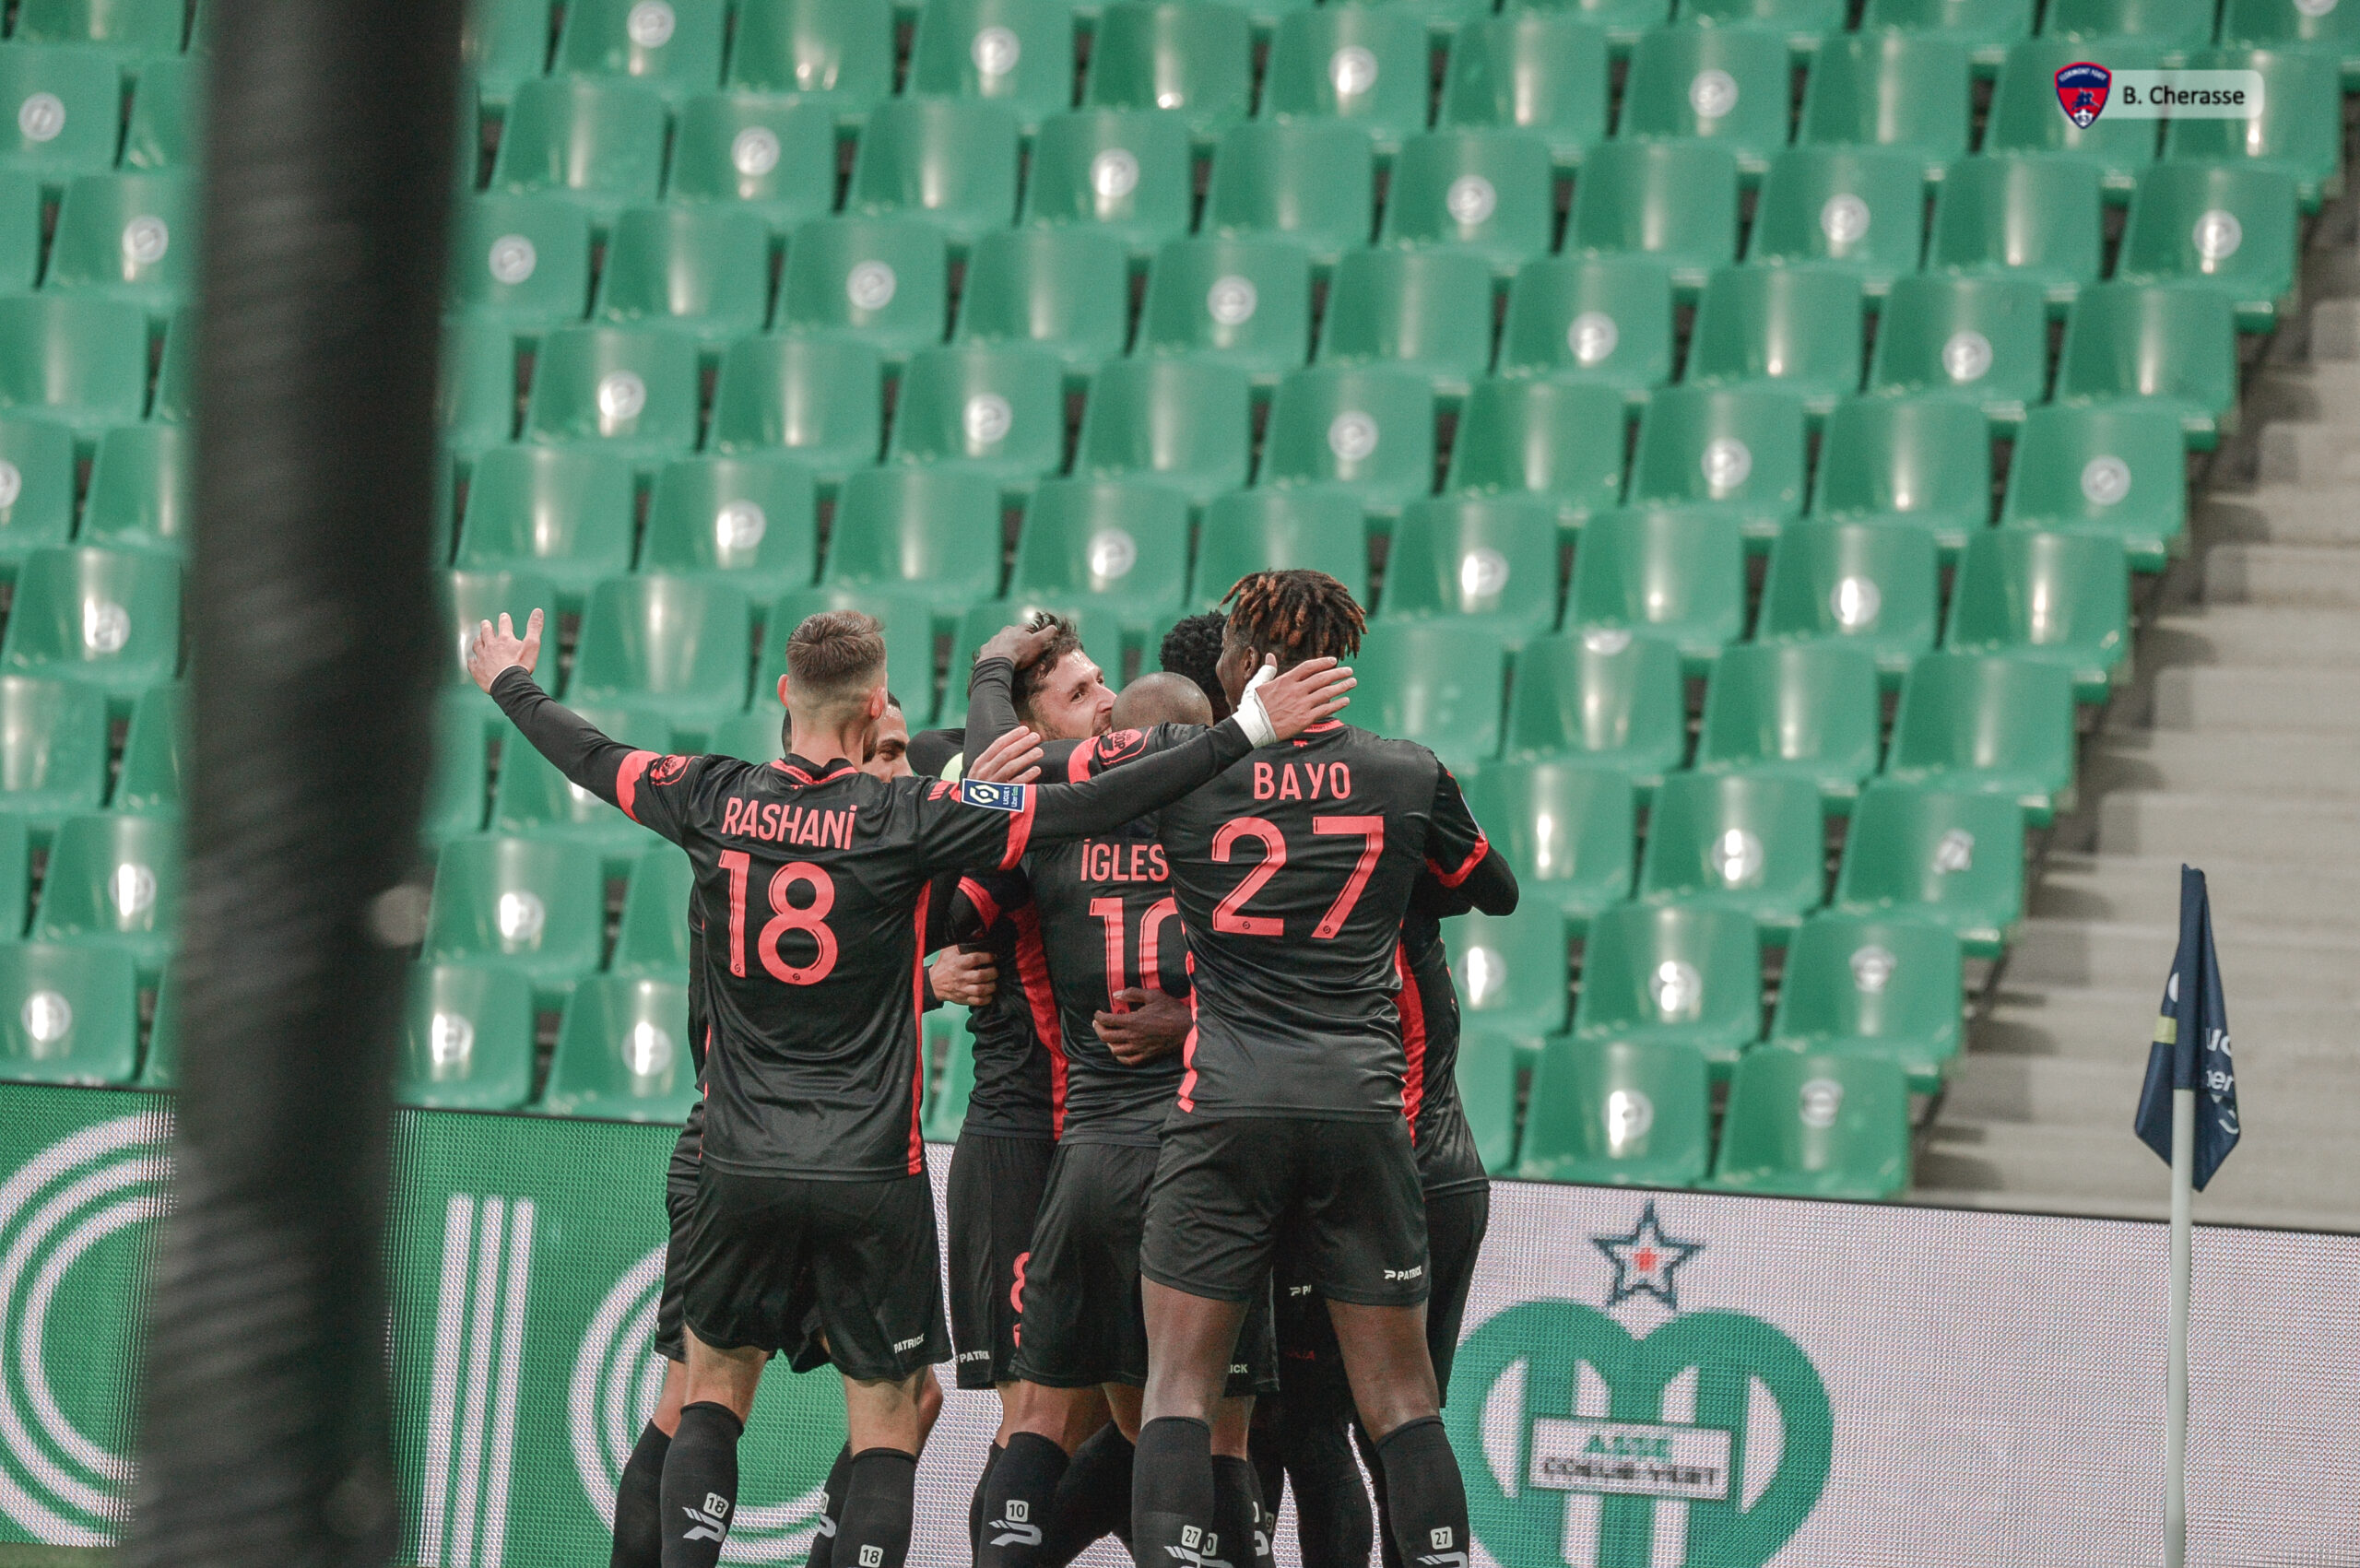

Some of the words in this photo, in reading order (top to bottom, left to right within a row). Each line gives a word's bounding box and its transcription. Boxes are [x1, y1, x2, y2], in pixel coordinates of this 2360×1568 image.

[1254, 761, 1351, 800] BAYO
[1081, 838, 1169, 882] IGLES
[1211, 816, 1384, 939] 27
[718, 849, 838, 985] 18
[707, 1496, 726, 1515] 18
[1009, 1503, 1026, 1518] 10
[1185, 1528, 1199, 1544] 27
[1434, 1530, 1448, 1546] 27
[862, 1548, 880, 1564] 18
